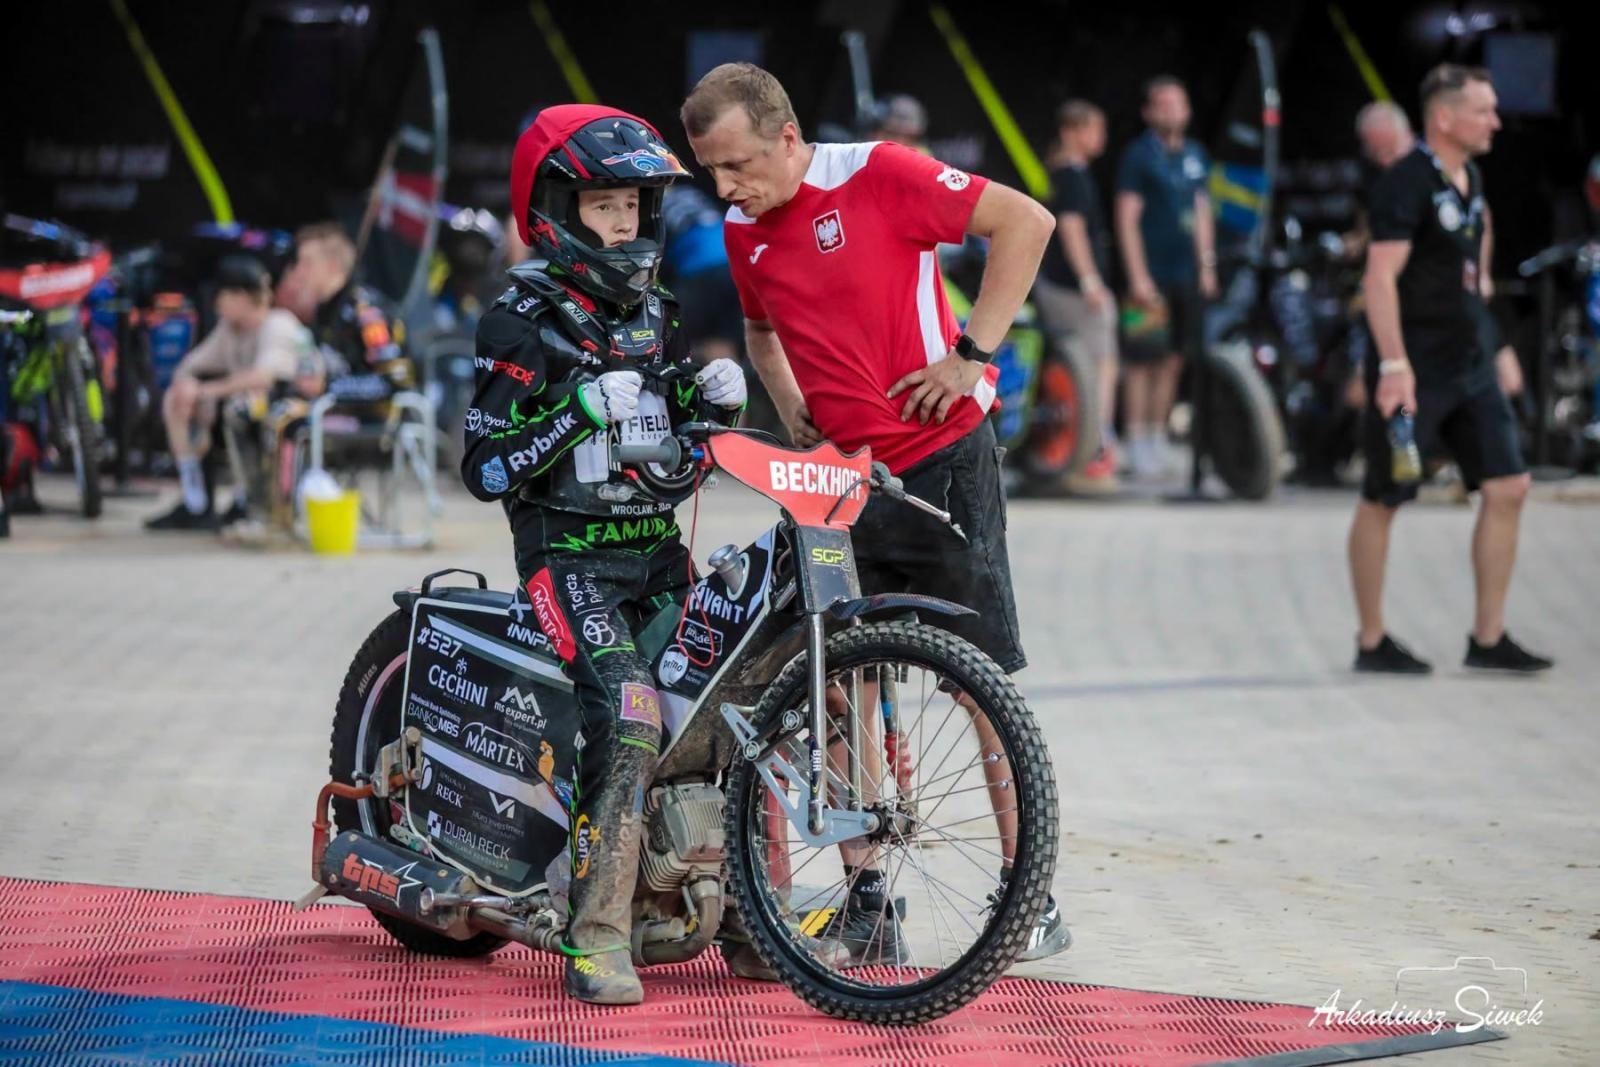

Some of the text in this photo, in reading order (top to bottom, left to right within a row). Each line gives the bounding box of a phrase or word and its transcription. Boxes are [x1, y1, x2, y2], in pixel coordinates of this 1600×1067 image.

[508, 412, 577, 472] Rybnik
[417, 627, 463, 658] #527
[428, 664, 488, 707] CECHINI
[505, 707, 547, 729] expert.pl
[465, 731, 525, 773] MARTEX
[436, 783, 464, 808] RECK
[445, 820, 477, 849] DURAJ
[479, 837, 511, 861] RECK
